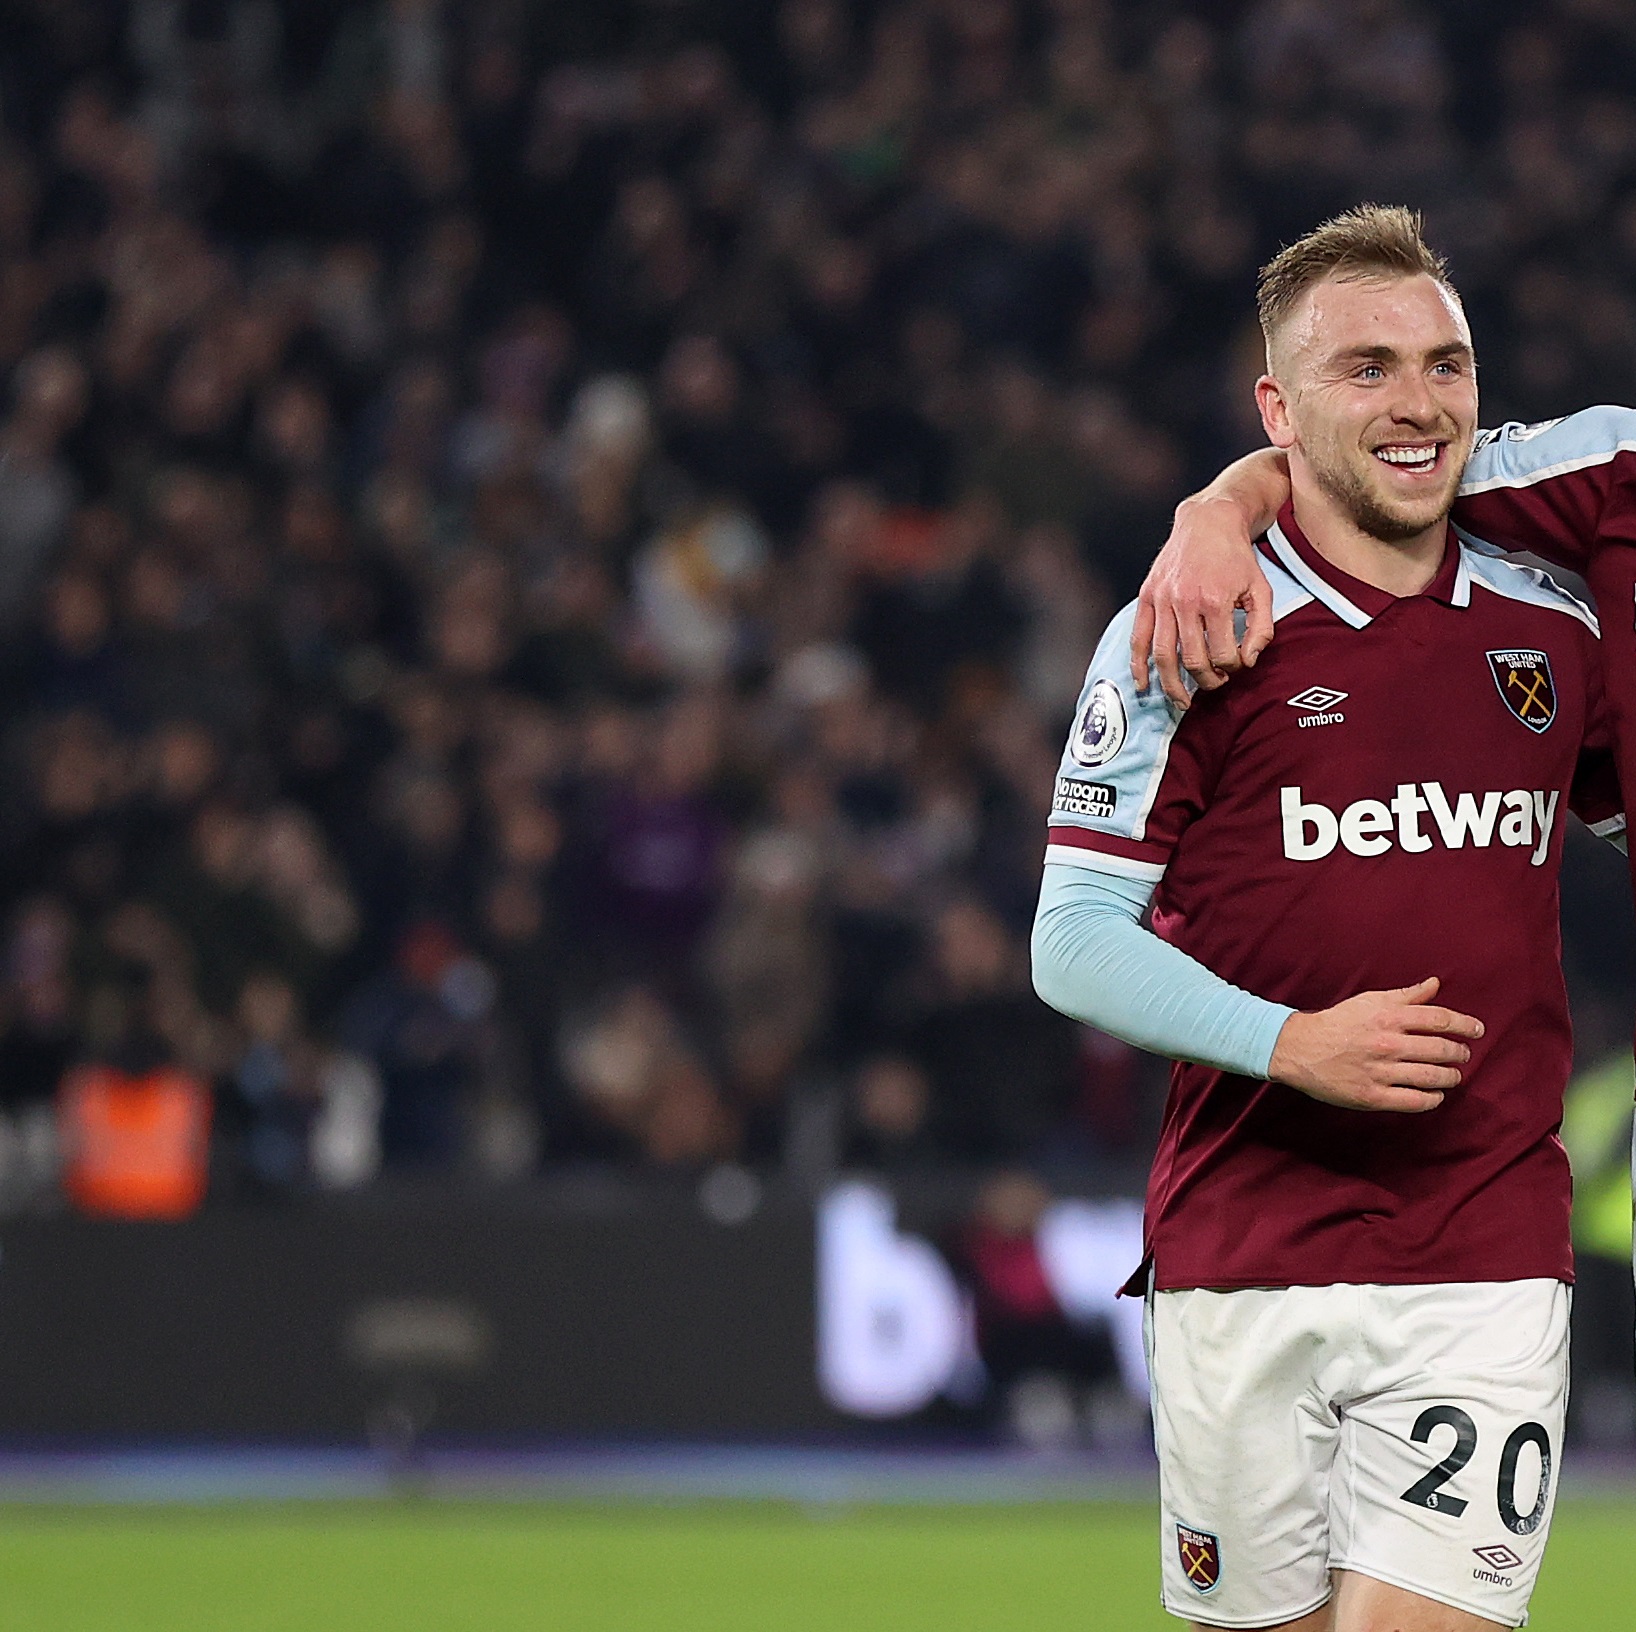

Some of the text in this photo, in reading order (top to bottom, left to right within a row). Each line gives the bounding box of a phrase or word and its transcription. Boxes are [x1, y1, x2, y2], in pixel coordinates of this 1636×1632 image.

[1494, 653, 1544, 664] WEST HAM
[1298, 711, 1344, 728] umbro
[1069, 782, 1109, 803] room
[1065, 797, 1115, 818] racism
[1280, 781, 1560, 866] betway
[1399, 1405, 1552, 1536] 20
[1473, 1568, 1513, 1588] umbro
